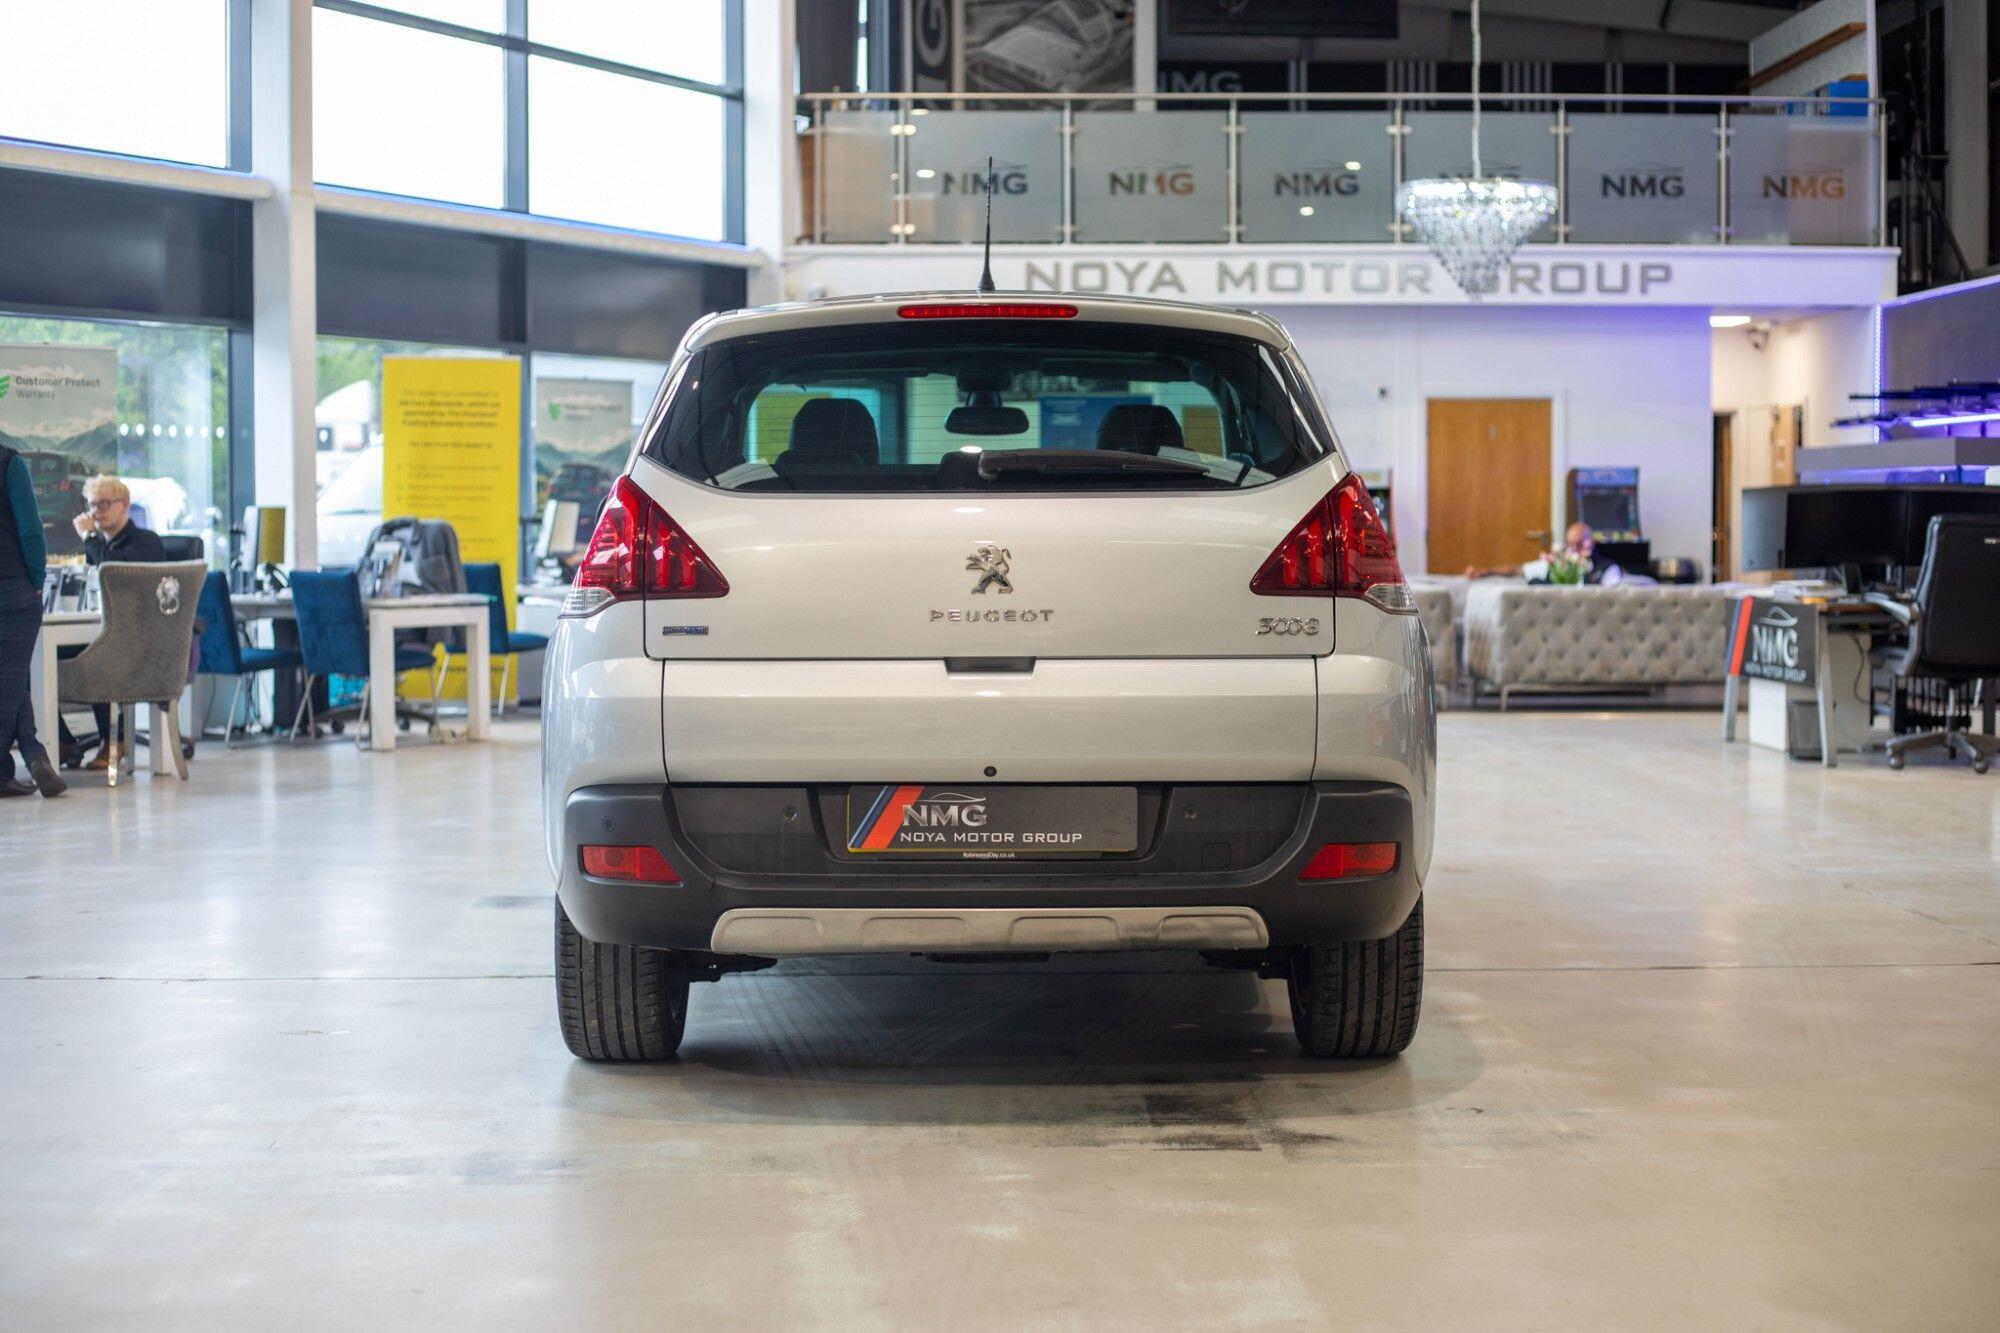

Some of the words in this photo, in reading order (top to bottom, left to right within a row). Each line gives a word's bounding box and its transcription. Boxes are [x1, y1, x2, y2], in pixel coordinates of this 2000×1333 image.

[942, 172, 1029, 196] NMG
[1274, 172, 1360, 196] NMG
[1602, 174, 1685, 197] NMG
[1763, 175, 1846, 199] NMG
[1025, 261, 1186, 294] NOYA
[1217, 262, 1433, 294] MOTOR
[1482, 262, 1673, 294] ROUP
[15, 376, 62, 386] Customer
[65, 377, 101, 388] Protect
[15, 388, 56, 400] Warranty
[929, 608, 1055, 622] PEUGEOT
[1254, 617, 1320, 636] 3008
[1751, 624, 1799, 668] NMG
[901, 804, 988, 828] NMG
[900, 832, 946, 843] NOYA
[953, 832, 1015, 843] MOTOR
[1022, 832, 1083, 843] GROUP
